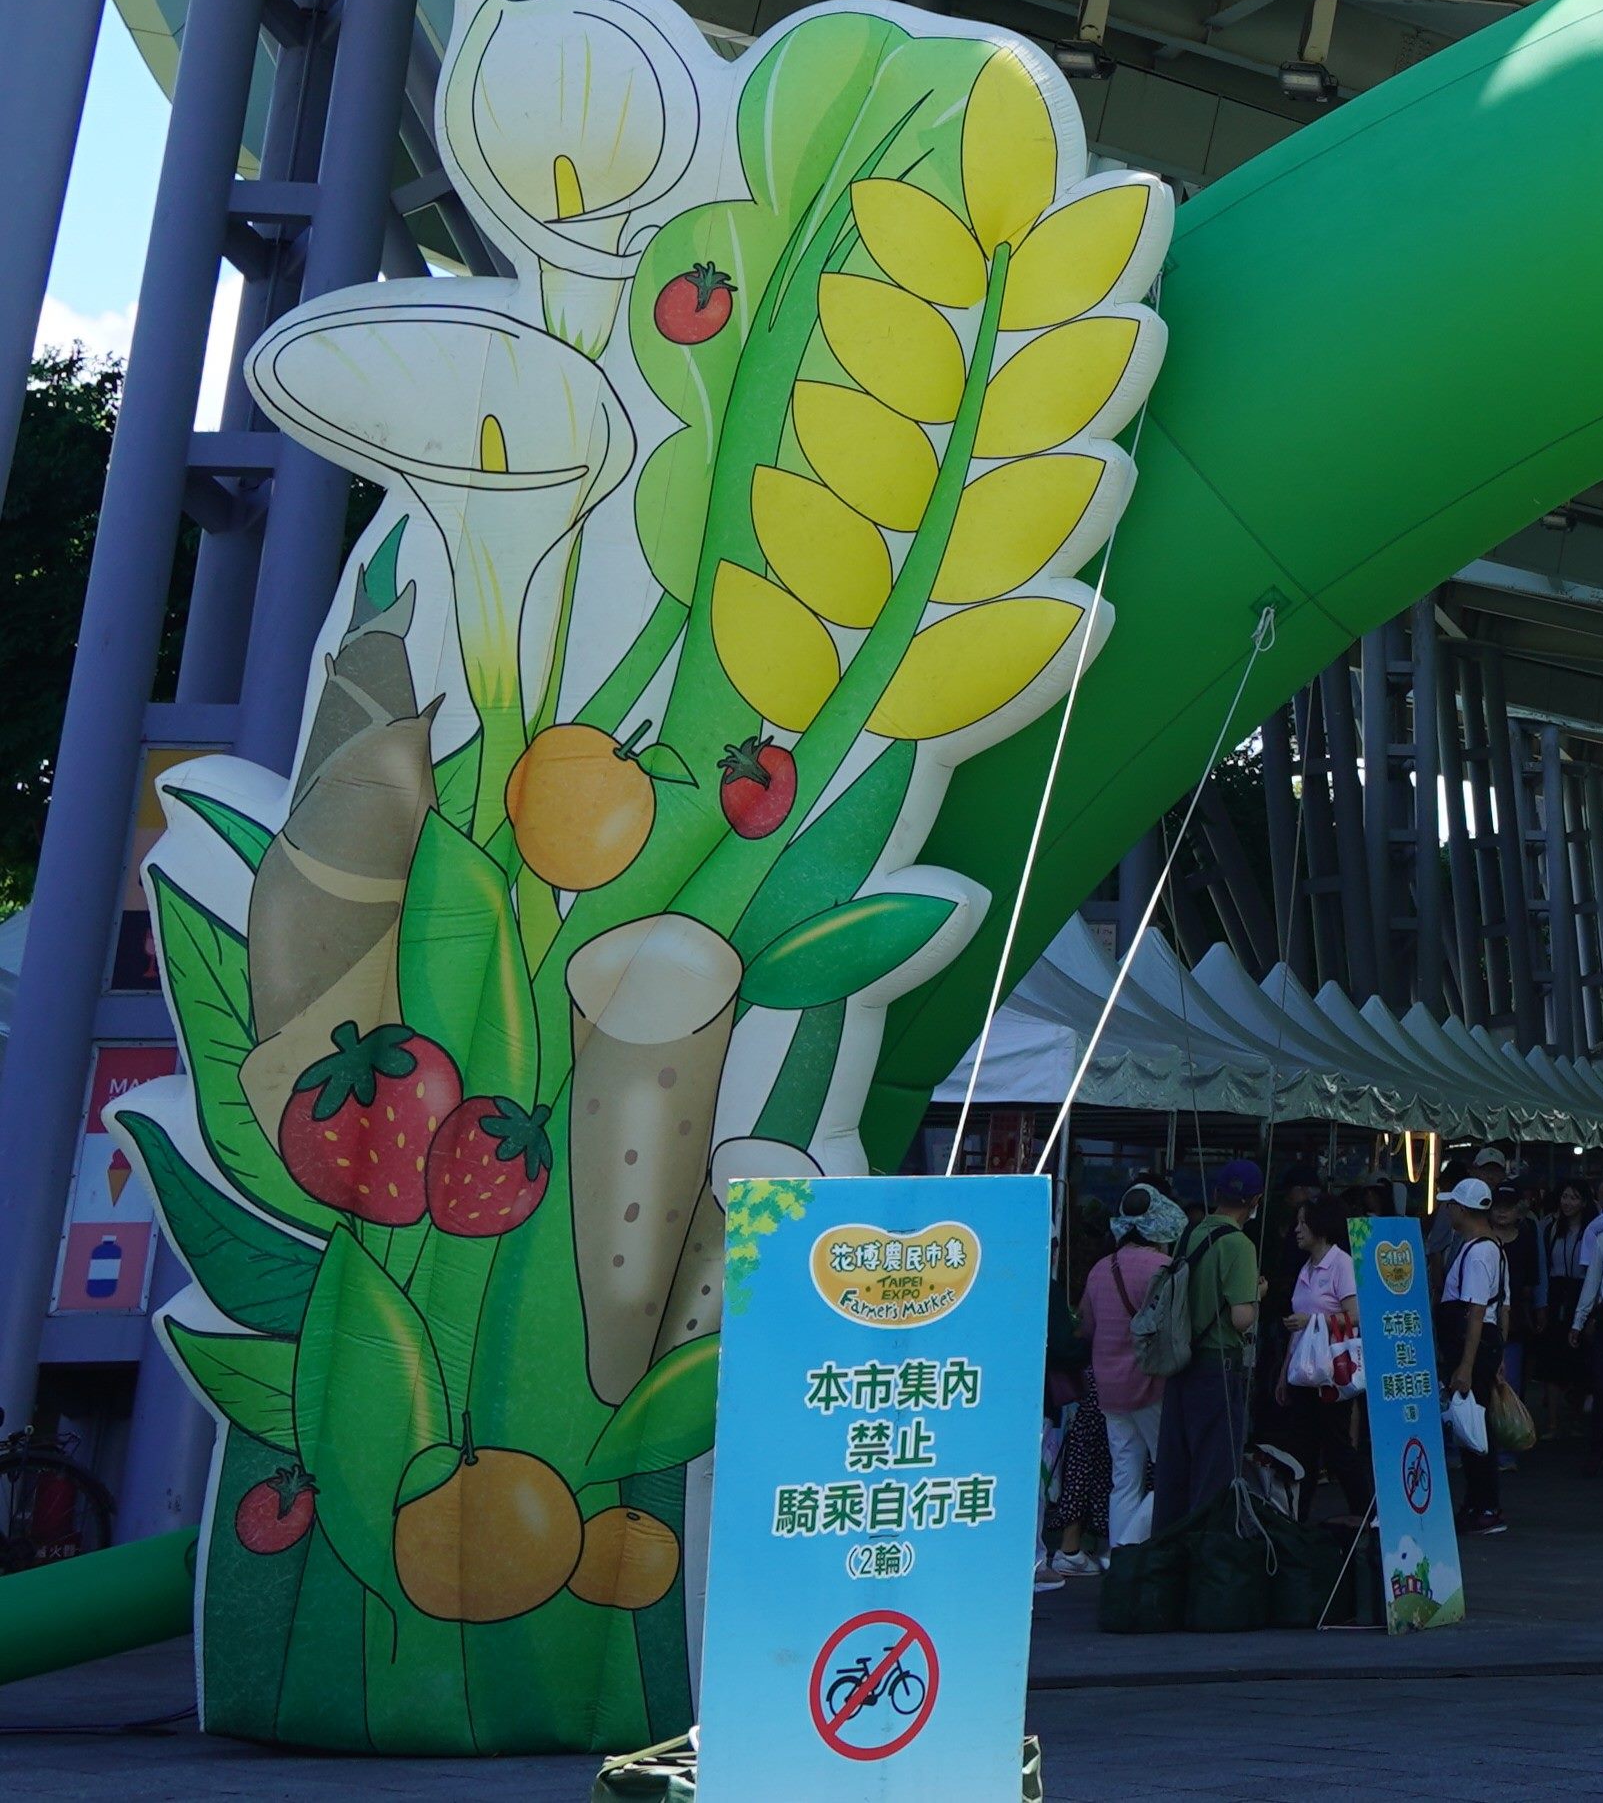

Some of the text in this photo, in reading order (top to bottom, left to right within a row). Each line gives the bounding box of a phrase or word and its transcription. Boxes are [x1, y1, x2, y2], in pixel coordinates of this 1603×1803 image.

[830, 1237, 966, 1273] 花博農民市集
[877, 1275, 923, 1288] TAIPEI
[881, 1288, 920, 1301] EXPO
[901, 1288, 957, 1319] Market
[805, 1358, 982, 1414] 本市集內
[847, 1418, 935, 1472] 禁止
[773, 1475, 996, 1536] 騎乘自行車
